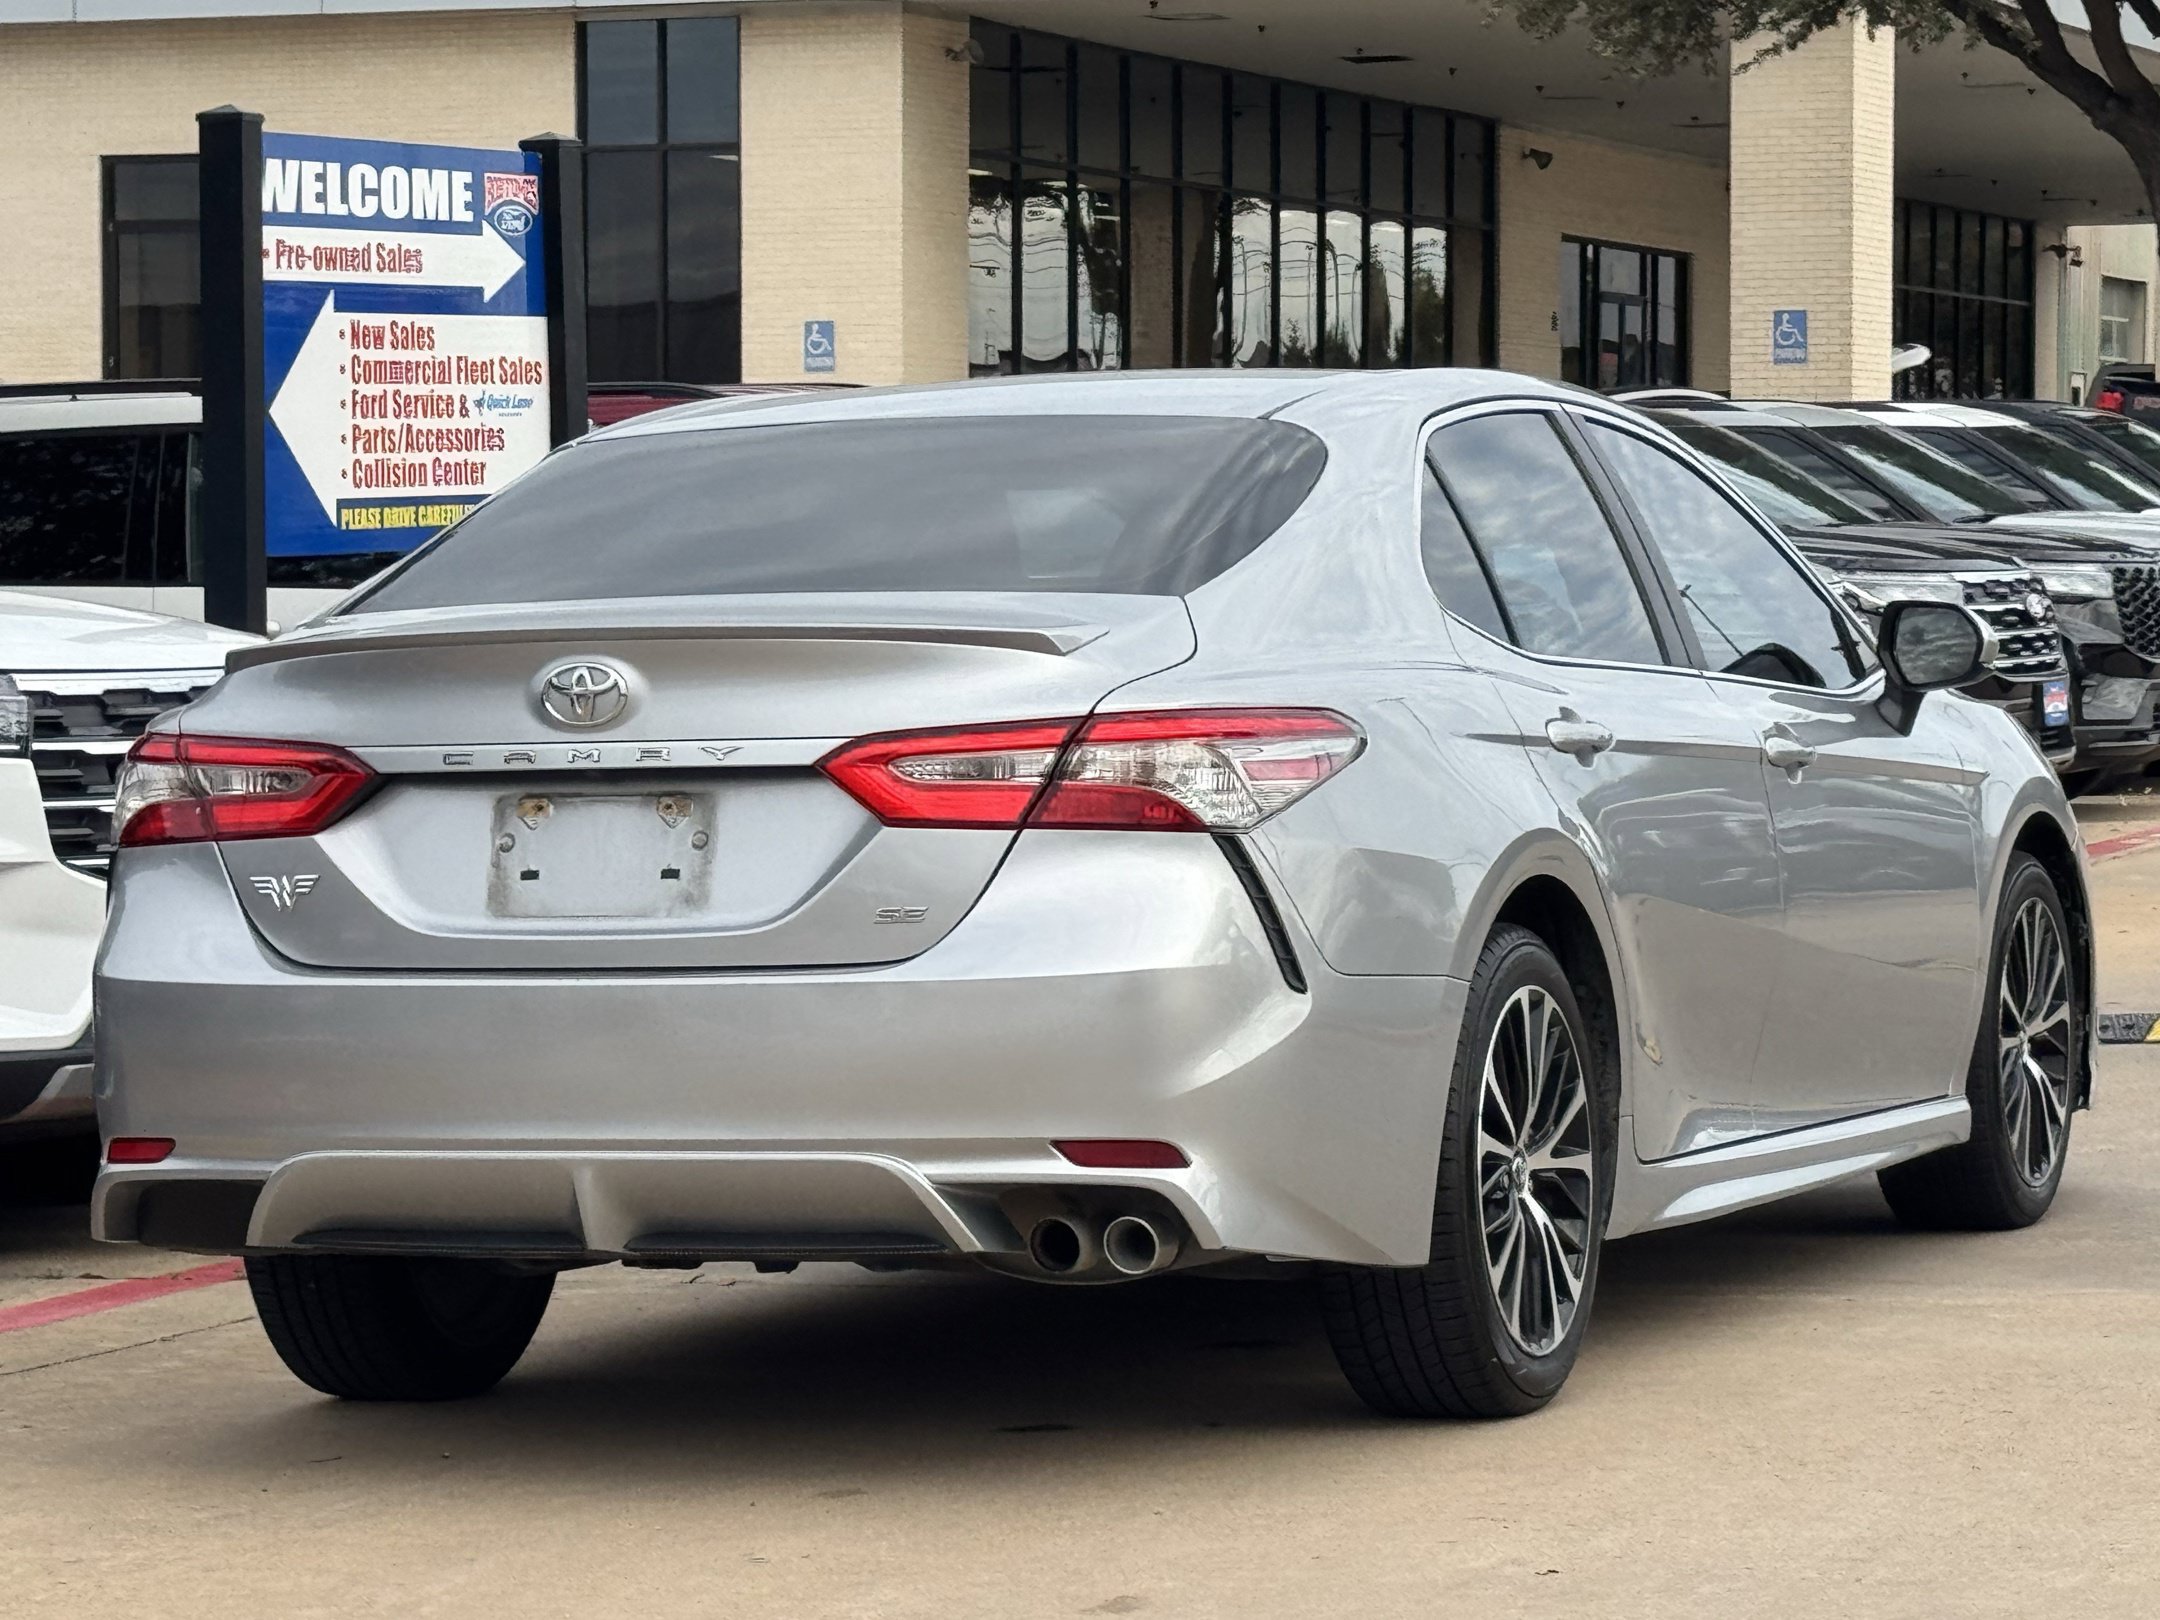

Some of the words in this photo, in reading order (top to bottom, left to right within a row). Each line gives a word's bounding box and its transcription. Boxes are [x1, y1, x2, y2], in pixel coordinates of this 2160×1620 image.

[262, 158, 474, 222] WELCOME
[275, 238, 372, 273] Pre-owned
[376, 242, 423, 274] Sales
[350, 319, 385, 350] New
[390, 320, 435, 351] Sales
[351, 354, 451, 385] Commercial
[456, 355, 495, 385] Fleet
[499, 357, 543, 385] Sales
[351, 389, 387, 420] Ford
[392, 389, 455, 419] Service
[459, 393, 470, 418] &
[352, 423, 505, 454] Parts/Accessories
[352, 458, 428, 488] Collision
[432, 457, 486, 486] Center
[340, 507, 382, 530] PLEASE
[443, 744, 744, 767] CAMRY
[873, 906, 929, 925] SE
